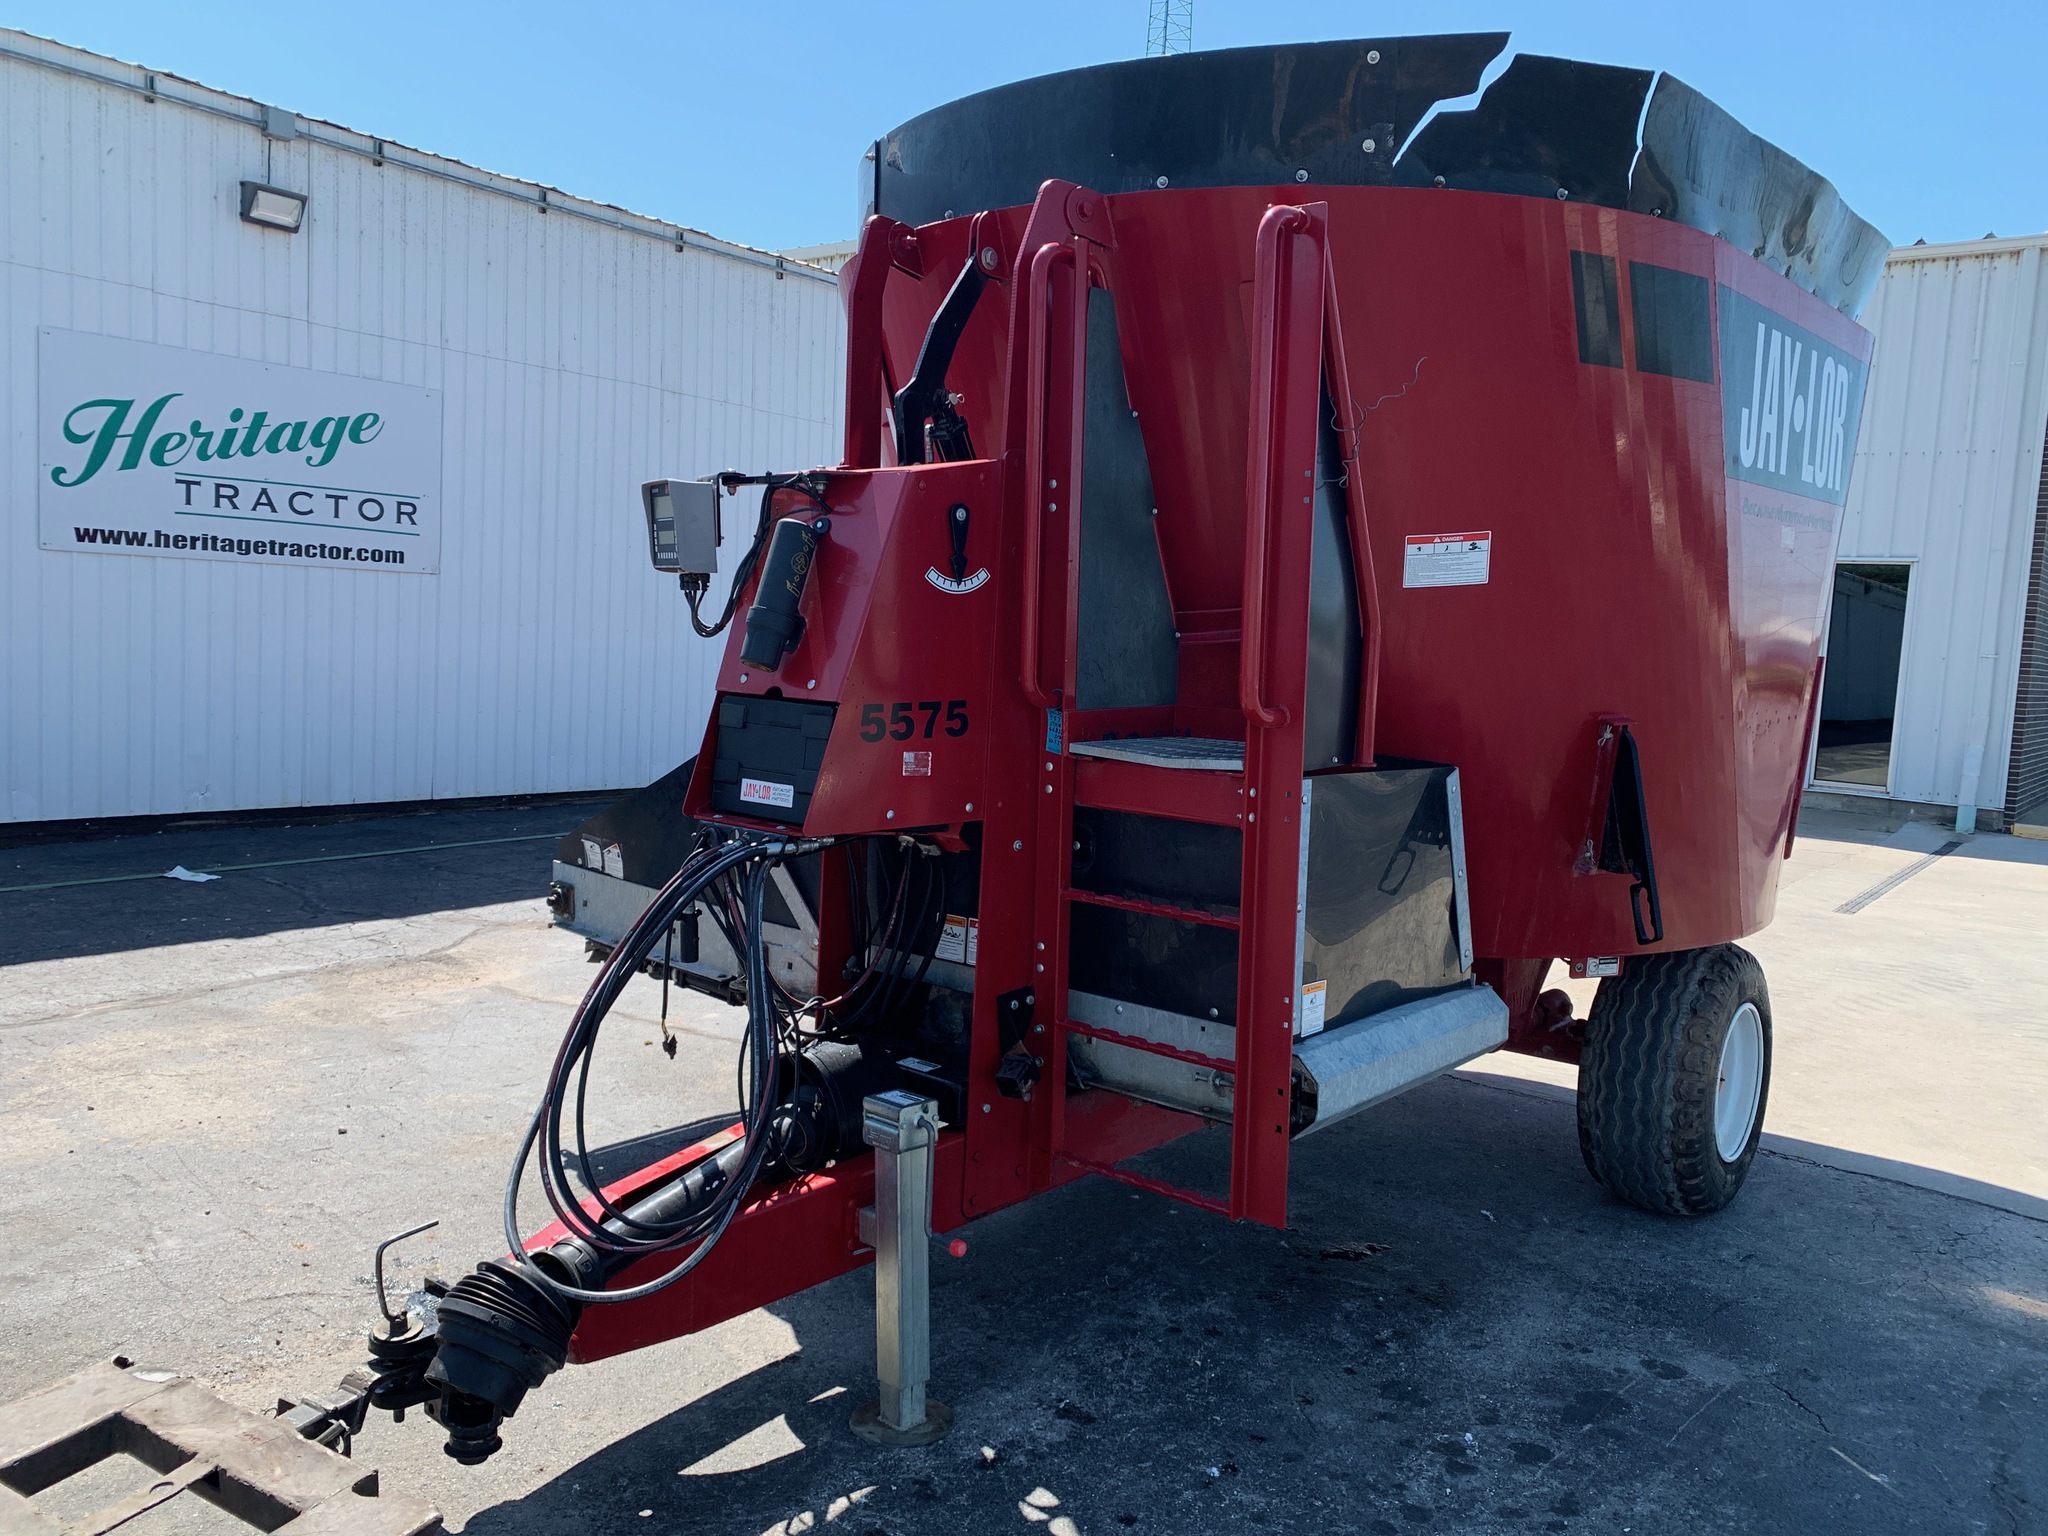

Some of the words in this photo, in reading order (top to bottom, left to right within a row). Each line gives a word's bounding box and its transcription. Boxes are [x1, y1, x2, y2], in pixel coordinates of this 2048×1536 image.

[51, 393, 385, 487] Heritage
[175, 478, 419, 526] TRACTOR
[74, 526, 405, 564] www.heritagetractor.com
[860, 700, 969, 744] 5575
